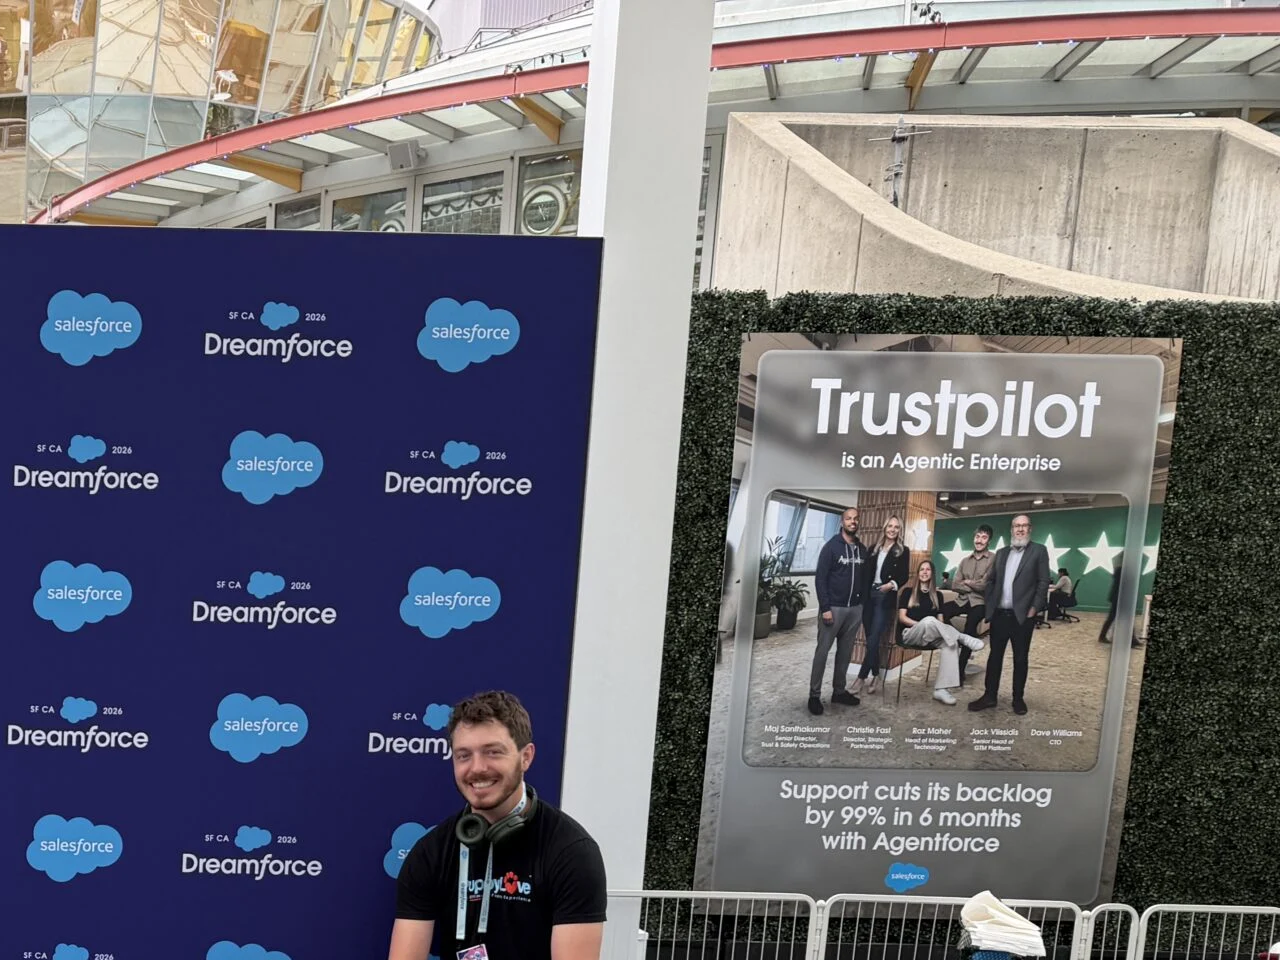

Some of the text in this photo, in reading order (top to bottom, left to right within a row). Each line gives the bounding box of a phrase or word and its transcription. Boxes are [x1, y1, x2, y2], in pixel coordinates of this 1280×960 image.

[55, 317, 131, 336] salesforce
[306, 313, 326, 321] 2026
[432, 324, 509, 343] salesforce
[205, 333, 352, 362] Dreamforce
[811, 378, 1101, 449] Trustpilot
[112, 446, 132, 454] 2026
[237, 457, 313, 475] salesforce
[841, 452, 1061, 474] is an Agentic Enterprise
[14, 465, 158, 494] Dreamforce
[385, 471, 532, 500] Dreamforce
[48, 586, 122, 603] salesforce
[415, 592, 490, 609] salesforce
[193, 601, 336, 629] Dreamforce
[224, 718, 298, 735] salesforce
[404, 713, 417, 721] CA
[8, 725, 148, 752] Dreamforce
[1053, 729, 1083, 737] Williams
[368, 732, 453, 760] Dream
[780, 780, 1052, 808] Support cuts its backlog
[805, 806, 1022, 828] by 99% in 6 months
[41, 839, 113, 855] salesforce
[822, 832, 1000, 856] with Agentforce
[182, 854, 322, 880] Dreamforce
[891, 872, 925, 881] salesforce
